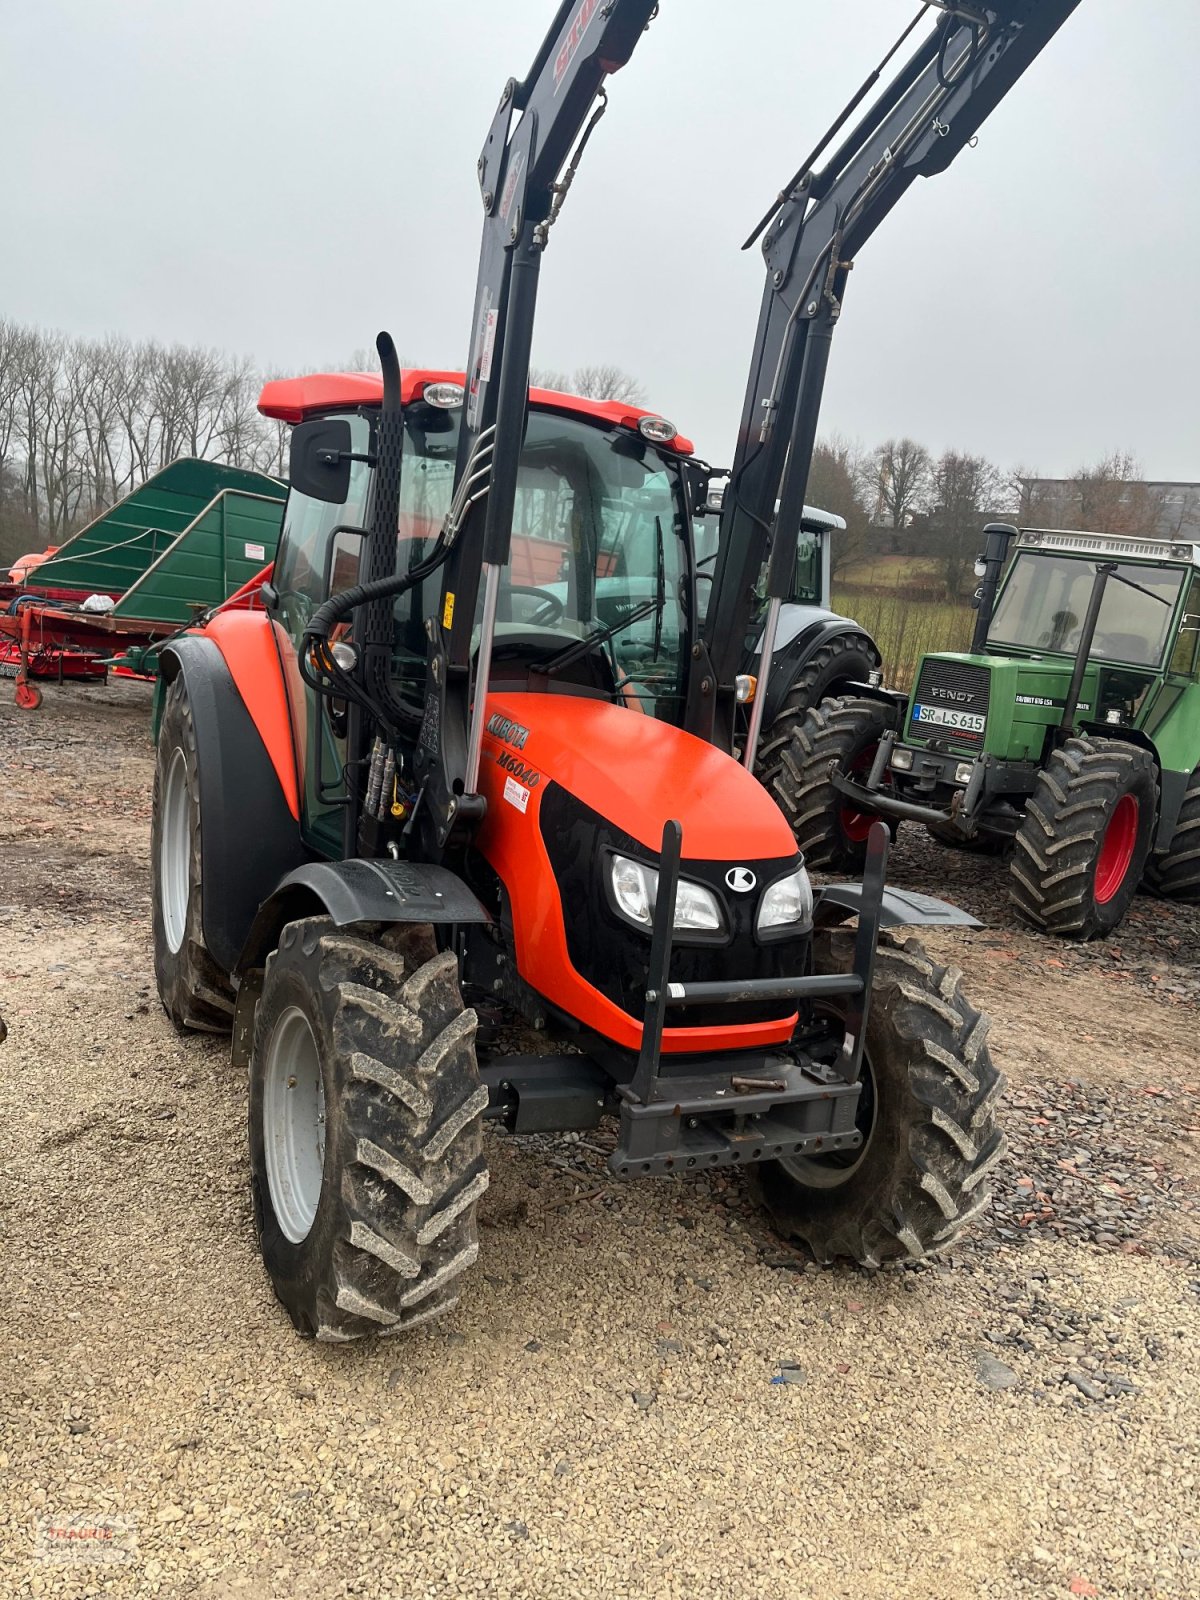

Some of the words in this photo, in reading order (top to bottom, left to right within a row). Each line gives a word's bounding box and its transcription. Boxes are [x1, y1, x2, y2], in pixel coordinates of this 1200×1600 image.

[931, 687, 975, 702] FENDT
[486, 712, 531, 750] KUBOTA
[920, 708, 936, 722] SR
[942, 712, 959, 726] LS
[960, 715, 983, 730] 615
[496, 750, 540, 788] M6040
